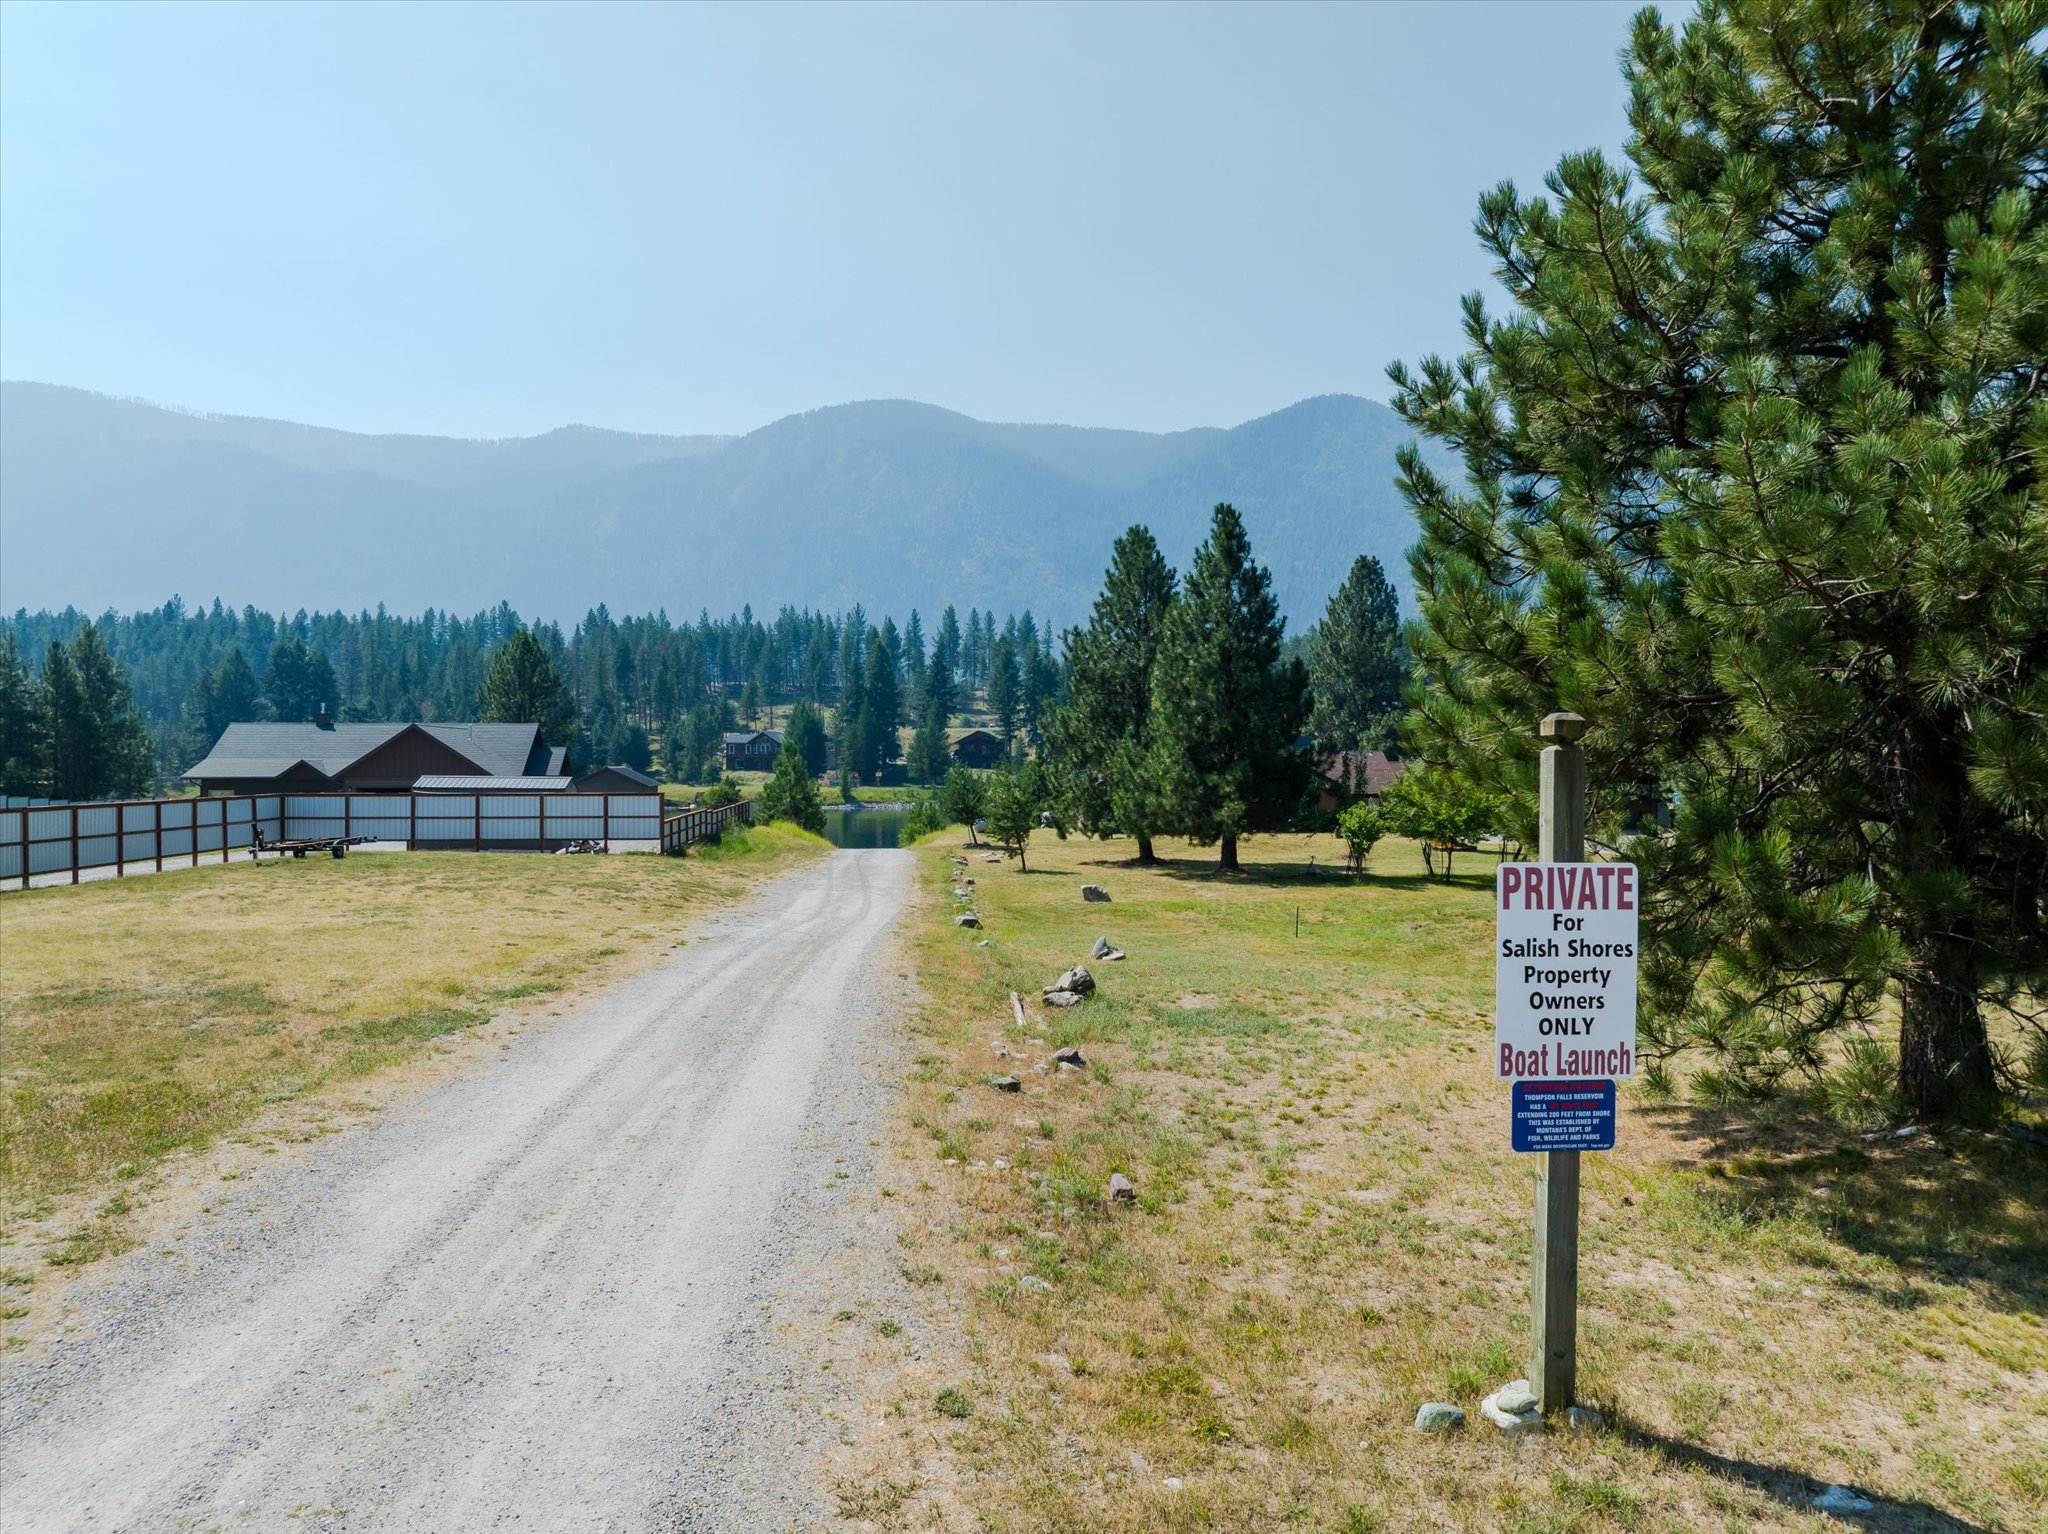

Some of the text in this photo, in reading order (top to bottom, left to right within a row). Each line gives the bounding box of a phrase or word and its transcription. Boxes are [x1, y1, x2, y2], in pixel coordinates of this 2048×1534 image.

[1502, 867, 1633, 910] PRIVATE
[1553, 913, 1584, 931] For
[1502, 938, 1633, 958] Salish Shores
[1524, 965, 1611, 988] Property
[1529, 991, 1605, 1010] Owners
[1538, 1017, 1595, 1036] ONLY
[1500, 1041, 1631, 1077] Boat Launch
[1573, 1092, 1604, 1100] RESERVOIR
